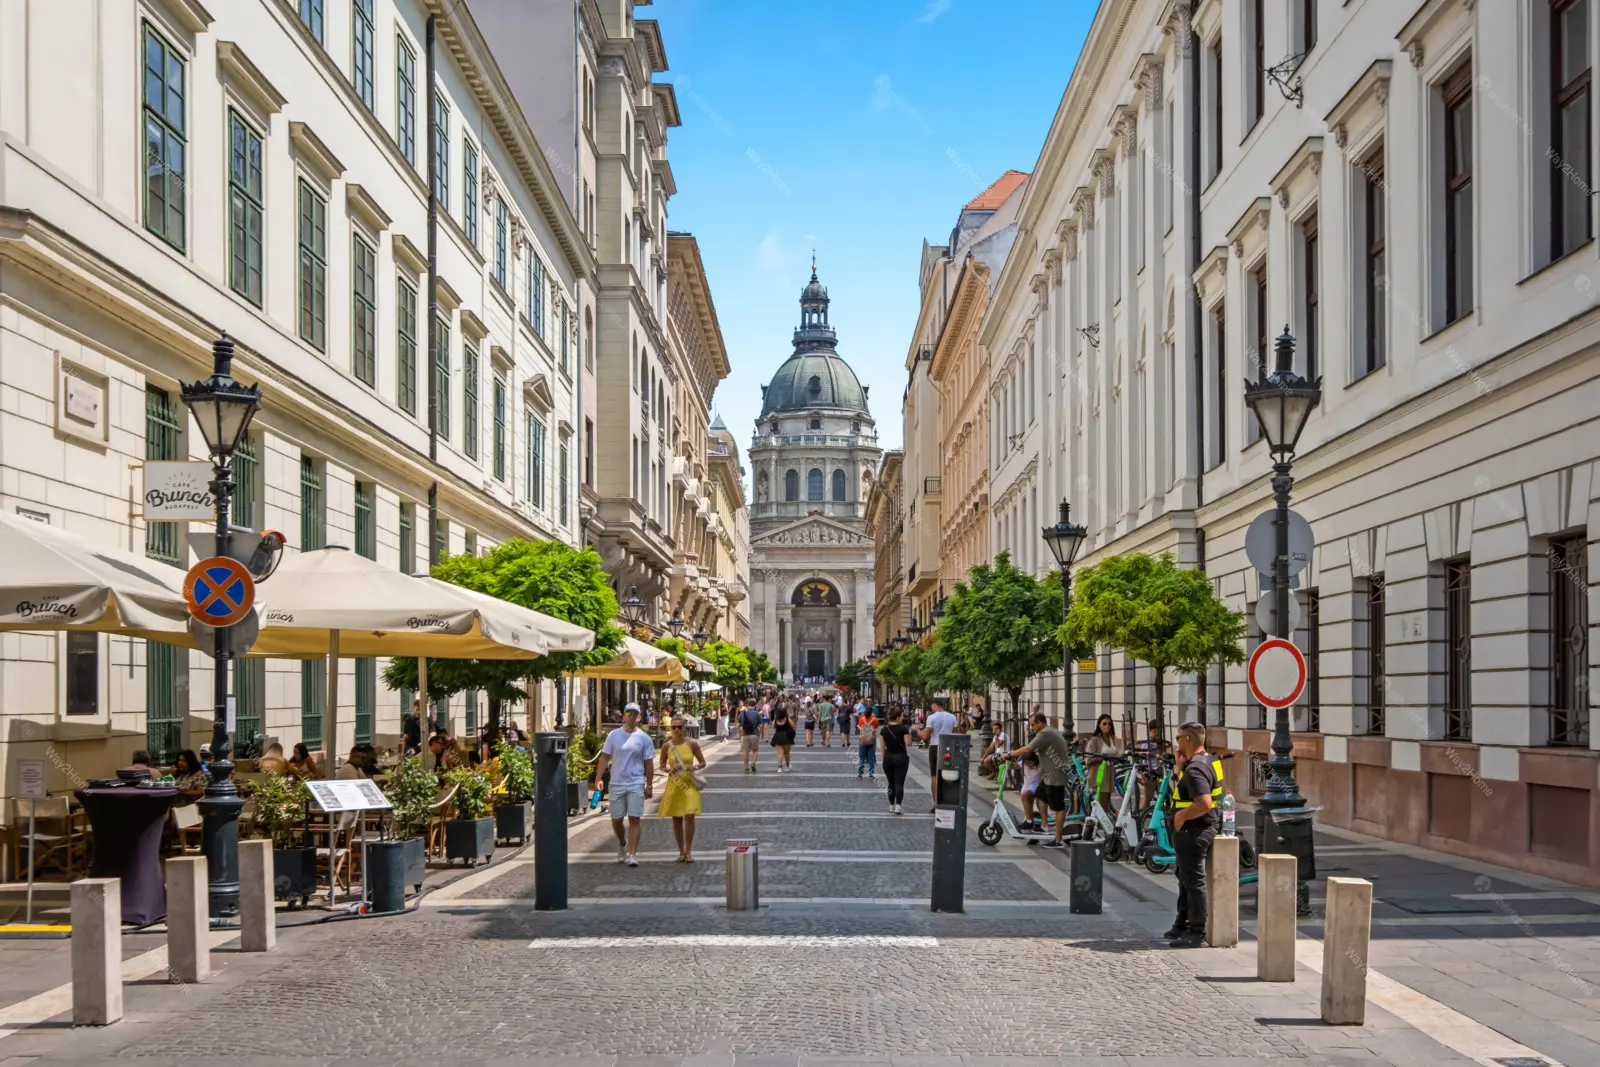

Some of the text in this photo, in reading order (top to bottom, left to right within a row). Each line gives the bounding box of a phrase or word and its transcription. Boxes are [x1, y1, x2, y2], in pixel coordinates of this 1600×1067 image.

[145, 489, 213, 507] Brunch
[16, 600, 78, 617] Brunch
[266, 613, 294, 623] unch
[406, 617, 451, 629] Brunch
